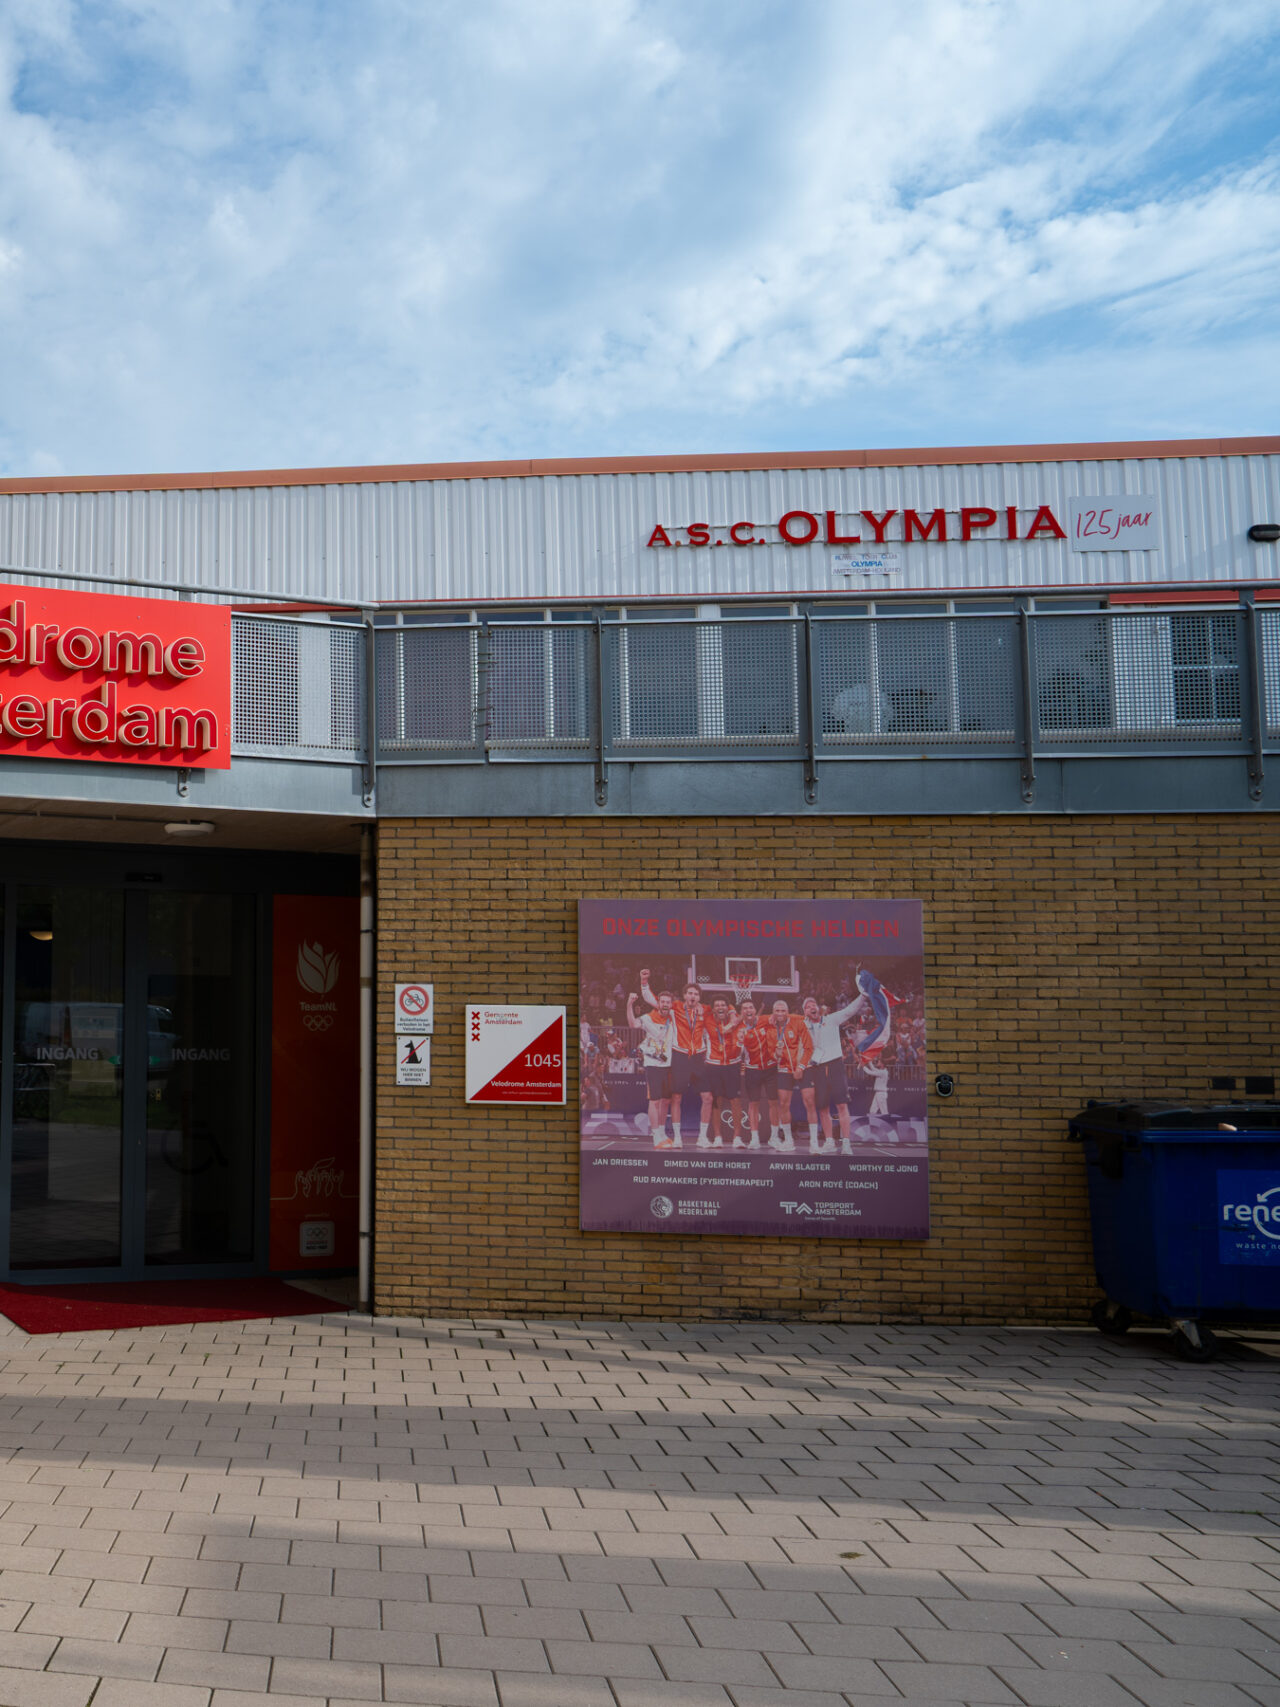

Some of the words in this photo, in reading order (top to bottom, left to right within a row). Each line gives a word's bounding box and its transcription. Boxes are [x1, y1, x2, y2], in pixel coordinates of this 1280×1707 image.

[646, 521, 766, 547] A.S.C.
[778, 505, 1068, 545] OLYMPIA
[1076, 508, 1113, 539] 125
[1109, 511, 1153, 540] jaar
[602, 917, 660, 937] ONZE
[666, 918, 805, 938] OLYMPISCHE
[812, 919, 900, 938] HELDEN
[300, 1001, 337, 1011] TeamNL
[36, 1047, 99, 1061] INGANG
[171, 1047, 231, 1061] INGANG
[524, 1053, 562, 1068] 1045
[592, 1158, 608, 1166] JAN
[610, 1158, 649, 1167] DRIESSEN
[690, 1160, 706, 1168] VAN
[708, 1161, 724, 1169] DER
[725, 1161, 752, 1169] HORST
[769, 1163, 794, 1171] ARVIN
[795, 1163, 831, 1171] SLAGTER
[849, 1164, 882, 1172] WORTHY
[884, 1164, 895, 1172] DE
[896, 1164, 919, 1173] JONG
[633, 1175, 649, 1184] RUD
[650, 1176, 698, 1185] RAYMAKERS
[798, 1180, 821, 1188] ARON
[822, 1179, 843, 1189] ROYÉ
[678, 1200, 721, 1208] BASKETBALL
[678, 1208, 718, 1216] NEDERLAND
[814, 1208, 862, 1216] AMSTERDAM
